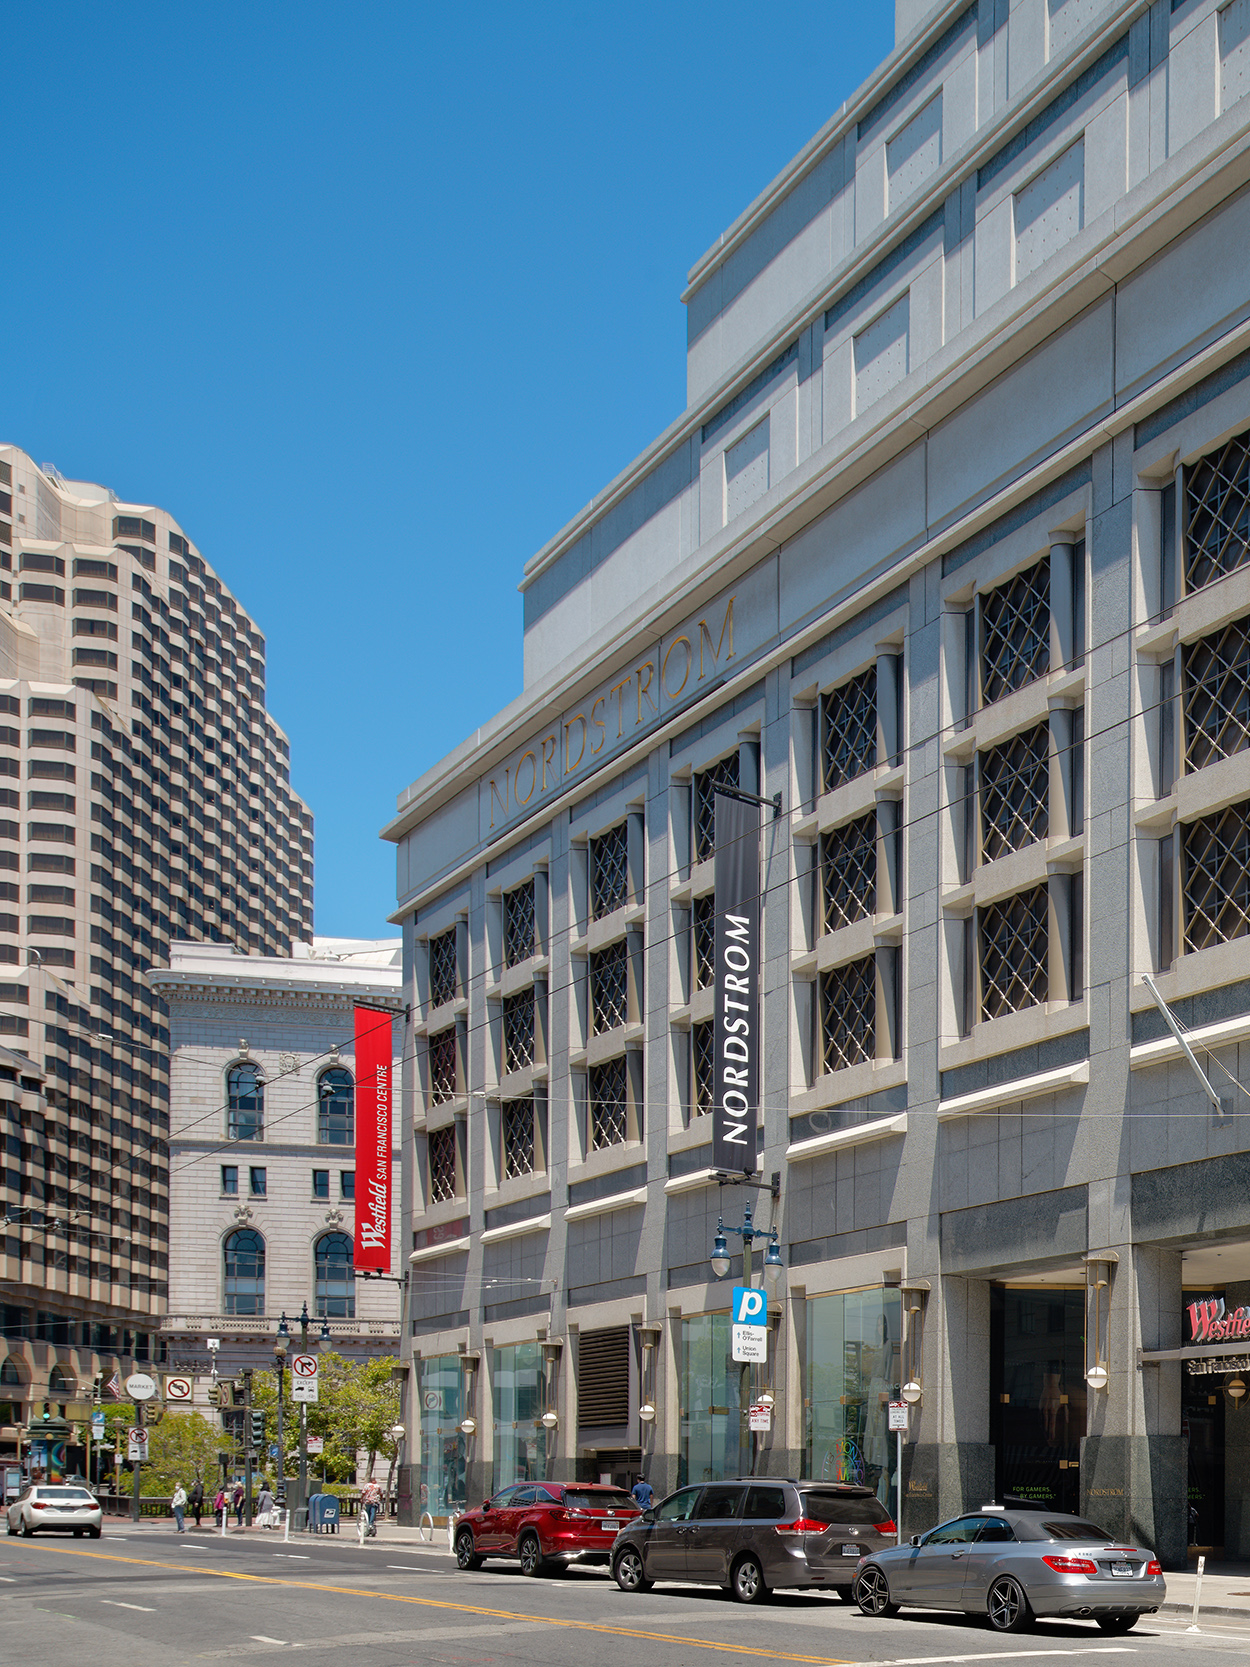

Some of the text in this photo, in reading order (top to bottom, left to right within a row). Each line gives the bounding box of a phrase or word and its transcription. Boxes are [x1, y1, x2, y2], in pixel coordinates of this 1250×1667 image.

[489, 595, 736, 828] NORDSTROM
[722, 914, 750, 1145] NORDSTROM
[361, 1064, 388, 1250] Westfield SAN FRANCISCO CENTRE
[1086, 1488, 1125, 1496] NORDSTROM
